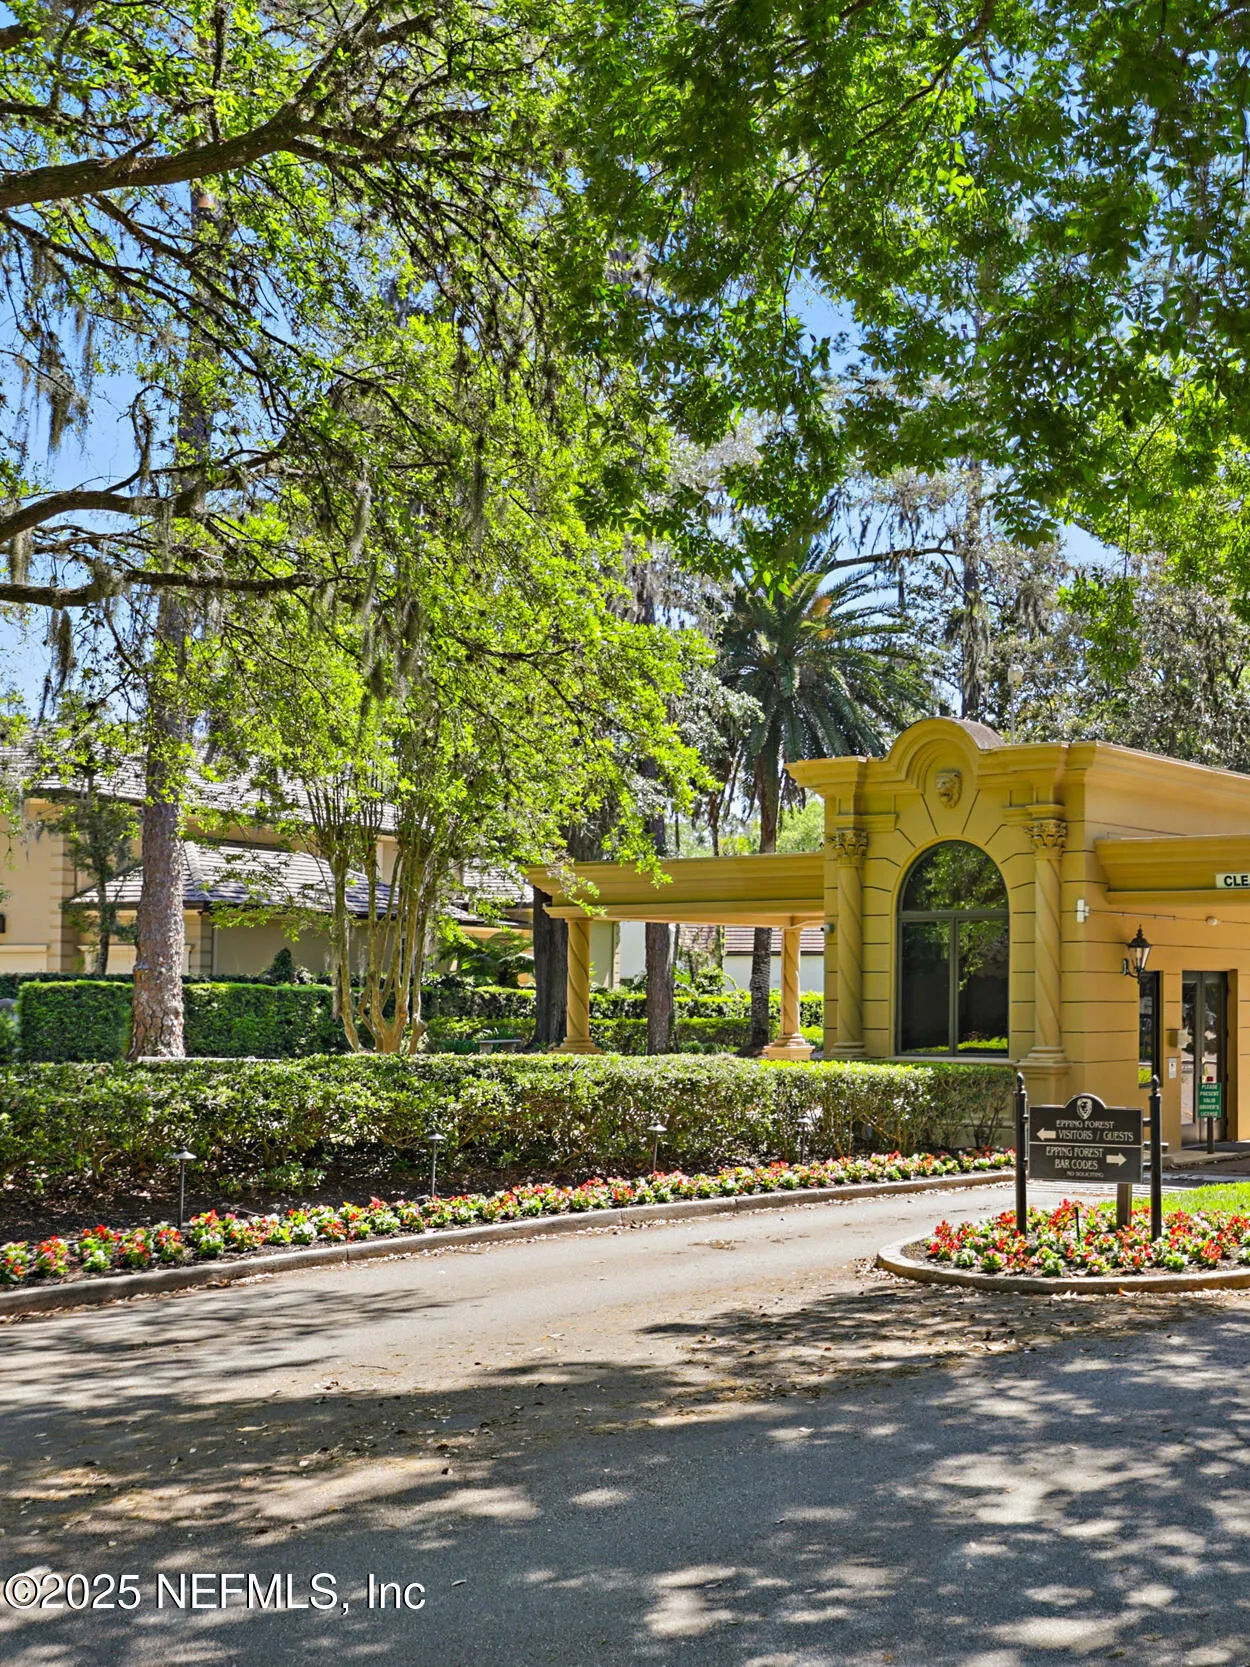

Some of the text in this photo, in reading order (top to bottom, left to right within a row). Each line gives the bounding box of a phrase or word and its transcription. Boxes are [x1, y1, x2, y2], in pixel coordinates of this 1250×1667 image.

[1056, 1119, 1115, 1129] EPPING FOREST
[1058, 1129, 1093, 1140] VISITORS
[1103, 1131, 1134, 1142] GUESTS
[1045, 1146, 1104, 1158] EPPING FOREST
[1055, 1159, 1098, 1170] BAR CODES
